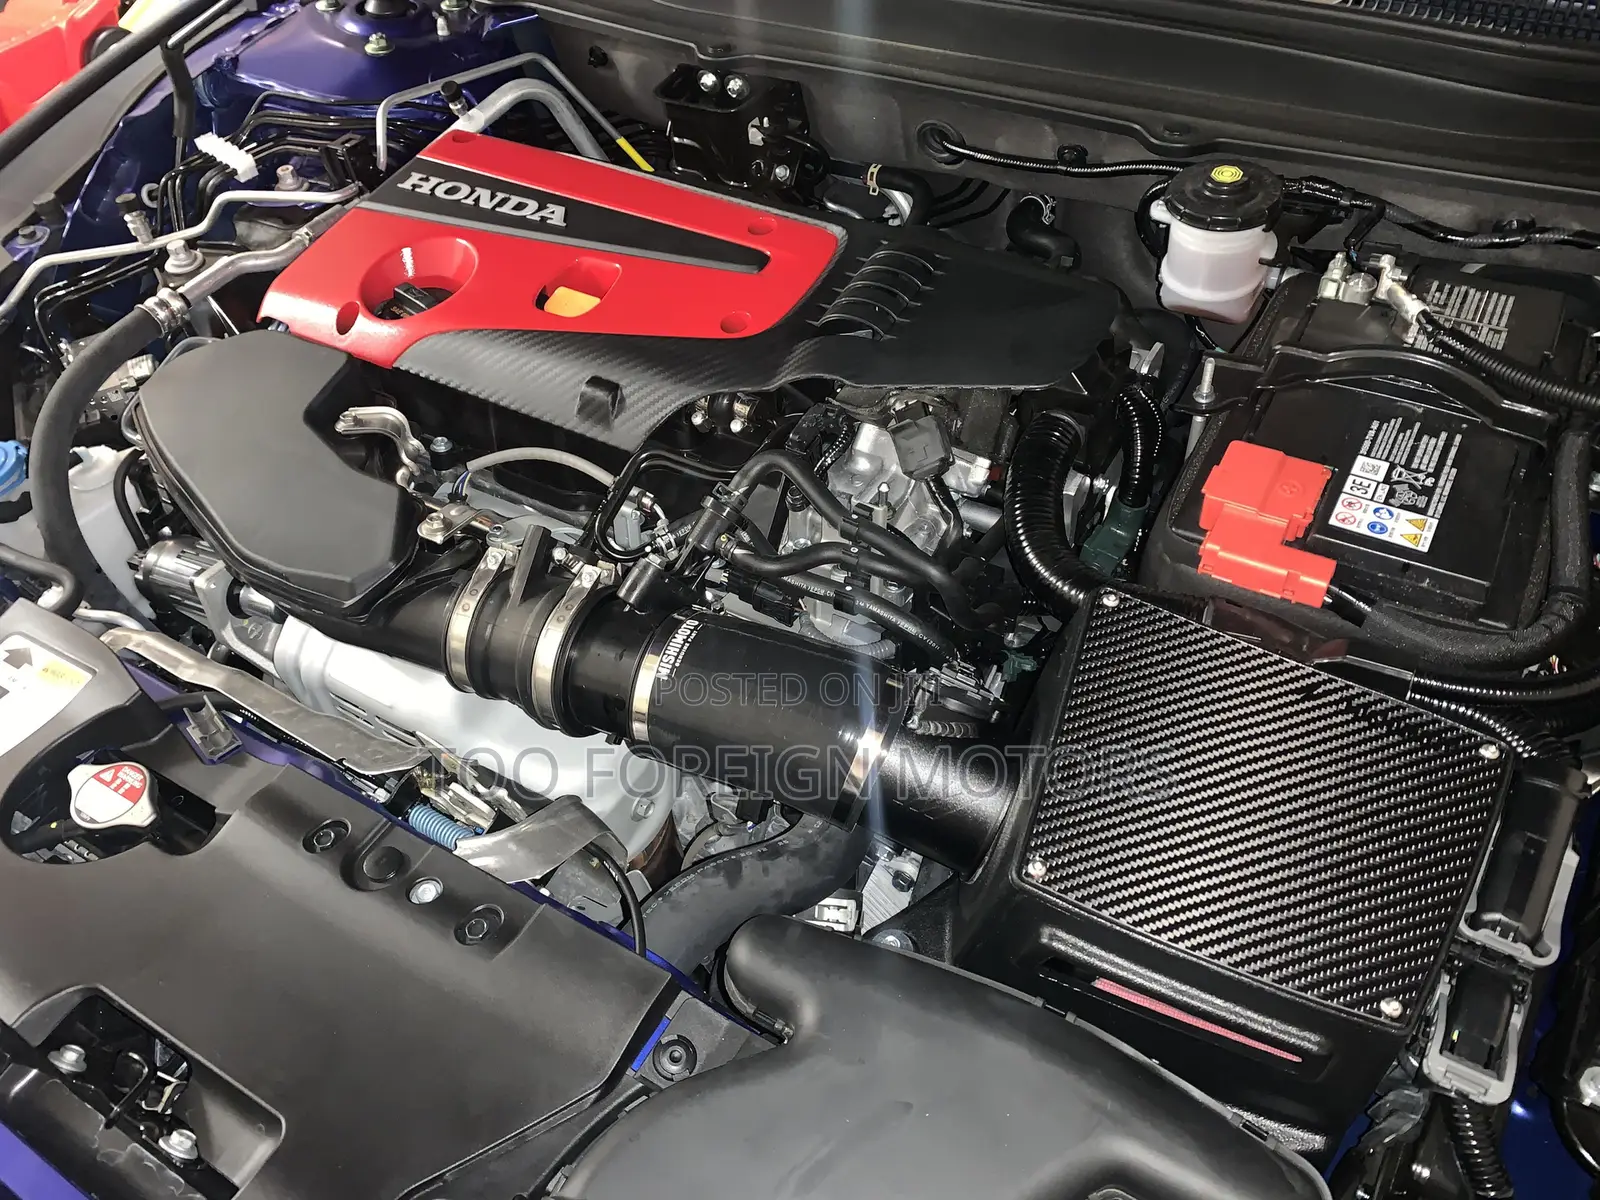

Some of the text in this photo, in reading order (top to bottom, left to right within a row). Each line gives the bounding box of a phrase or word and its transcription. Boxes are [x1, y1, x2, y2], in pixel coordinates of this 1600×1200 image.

[397, 172, 567, 227] HONDA
[1350, 479, 1372, 495] 3E
[865, 603, 897, 624] YAMASHITA
[656, 619, 699, 681] MISHIMOTO
[675, 630, 698, 667] GENUINE PART
